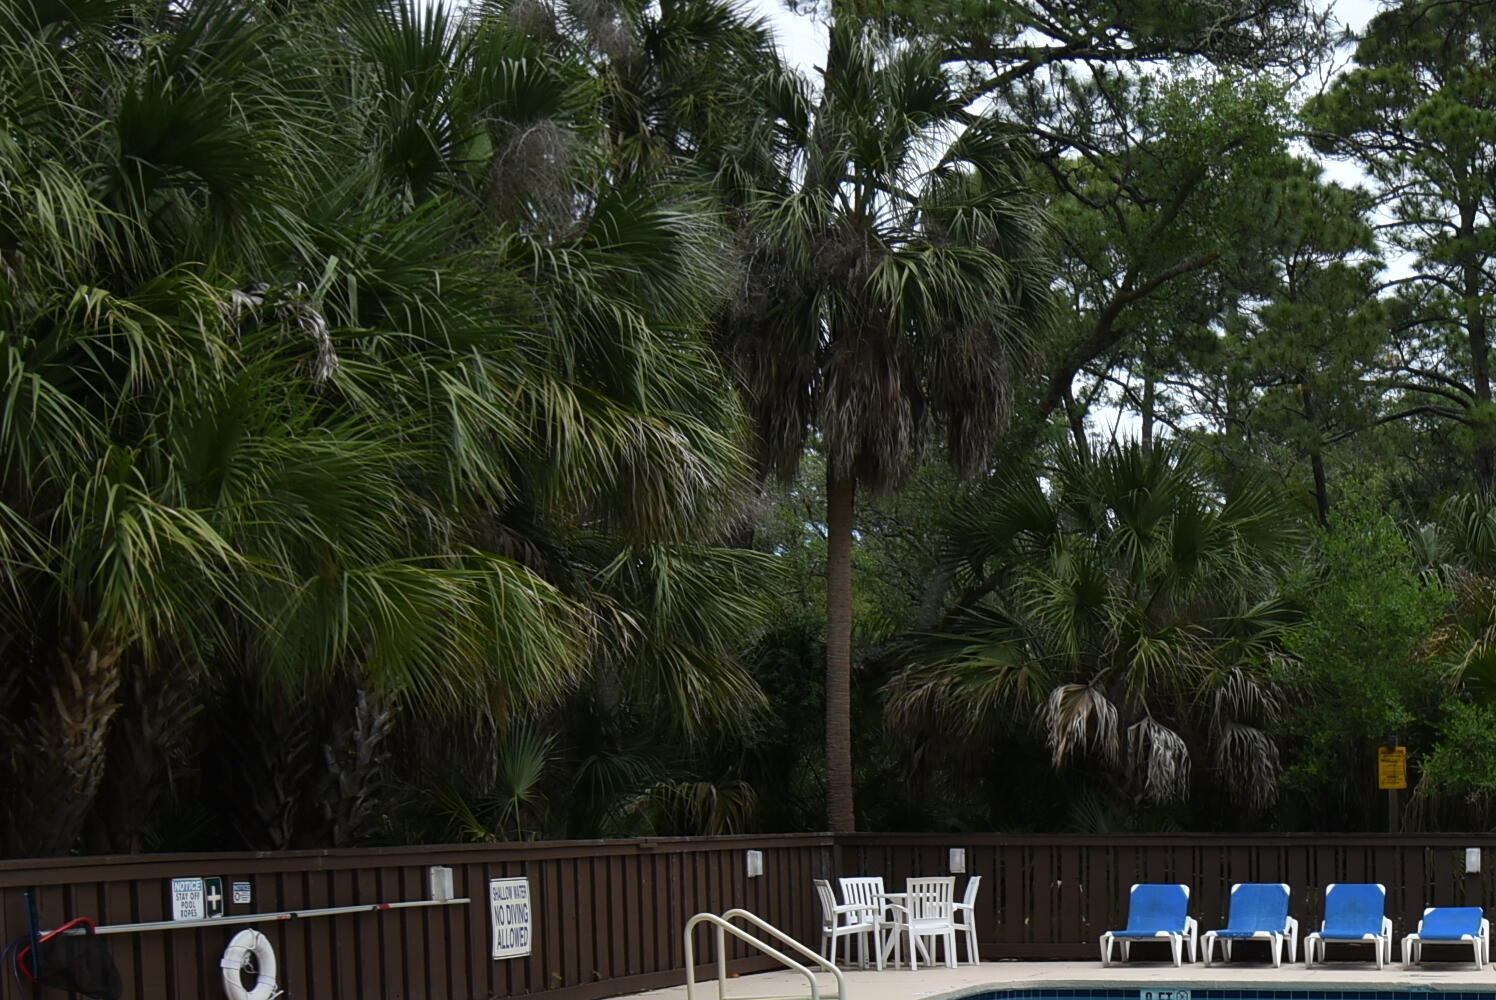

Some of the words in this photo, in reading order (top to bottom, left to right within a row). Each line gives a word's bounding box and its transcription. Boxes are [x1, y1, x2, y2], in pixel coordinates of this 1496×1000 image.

[174, 880, 201, 891] NOTICE
[176, 892, 188, 901] STAY
[190, 892, 200, 900] OFF
[181, 900, 196, 909] POOL
[180, 909, 197, 918] ROPES
[494, 905, 504, 926] NO
[506, 903, 528, 925] DIVING
[496, 927, 528, 950] ALLOWED
